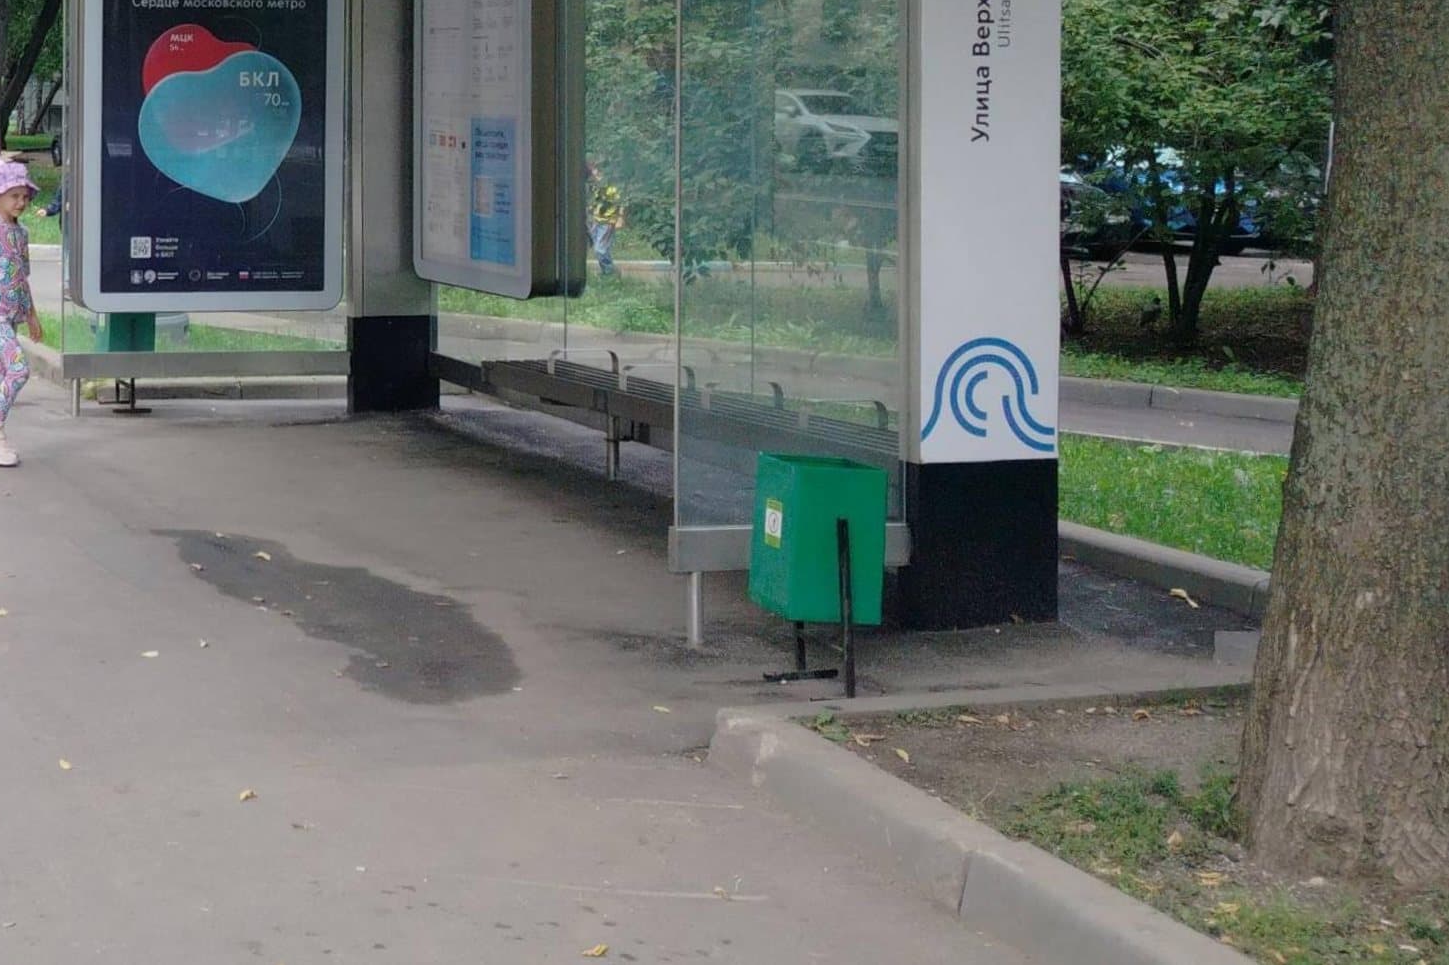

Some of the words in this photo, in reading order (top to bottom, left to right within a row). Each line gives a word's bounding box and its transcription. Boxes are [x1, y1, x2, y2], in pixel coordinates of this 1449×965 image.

[266, 0, 306, 10] метро
[997, 0, 1012, 48] Ulitsa
[170, 34, 193, 43] МЦК
[239, 71, 279, 87] БКЛ
[264, 93, 281, 107] 70
[971, 65, 993, 142] Улица
